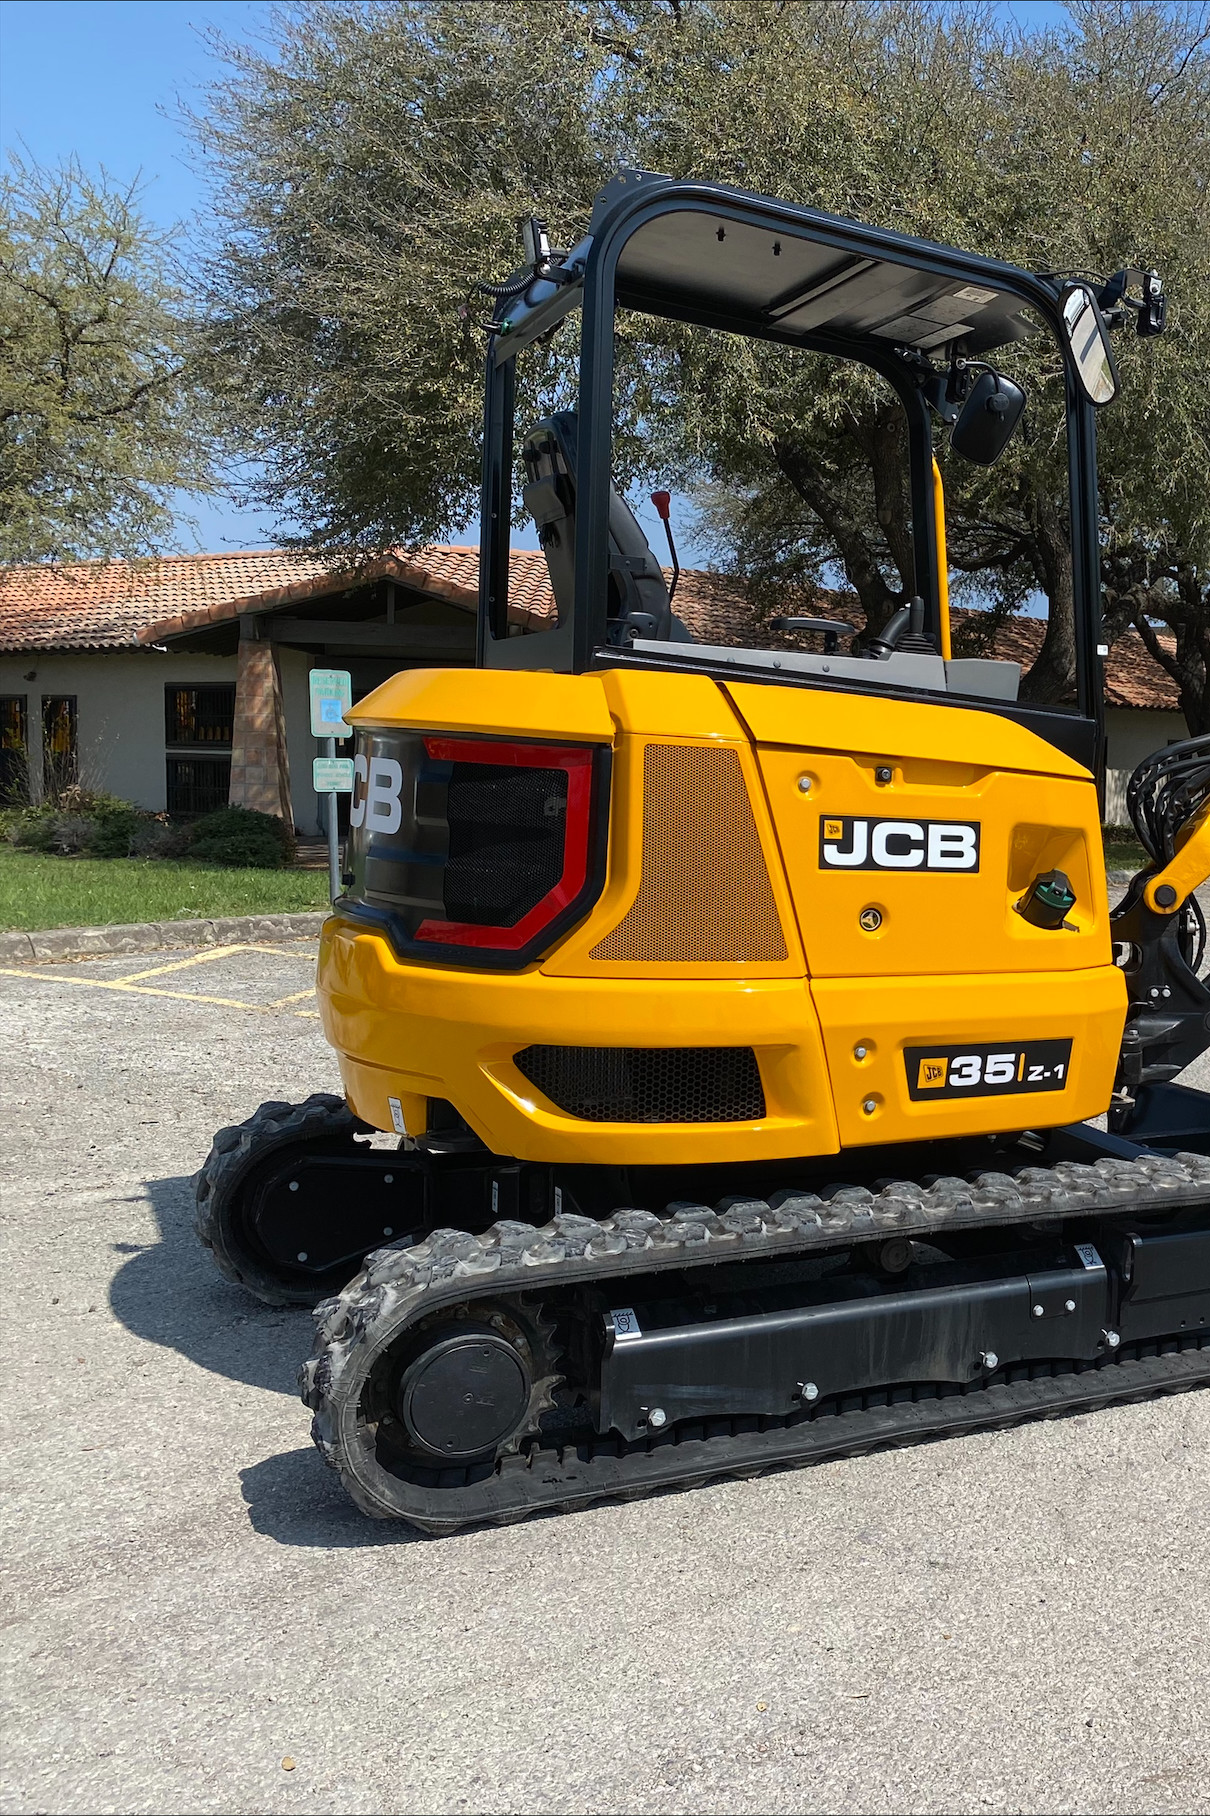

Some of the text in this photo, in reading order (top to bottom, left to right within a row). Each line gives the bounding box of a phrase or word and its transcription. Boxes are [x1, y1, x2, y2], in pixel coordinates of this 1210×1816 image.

[350, 754, 402, 834] CB
[823, 820, 977, 869] JCB
[924, 1054, 1065, 1087] JCB 35 Z-1
